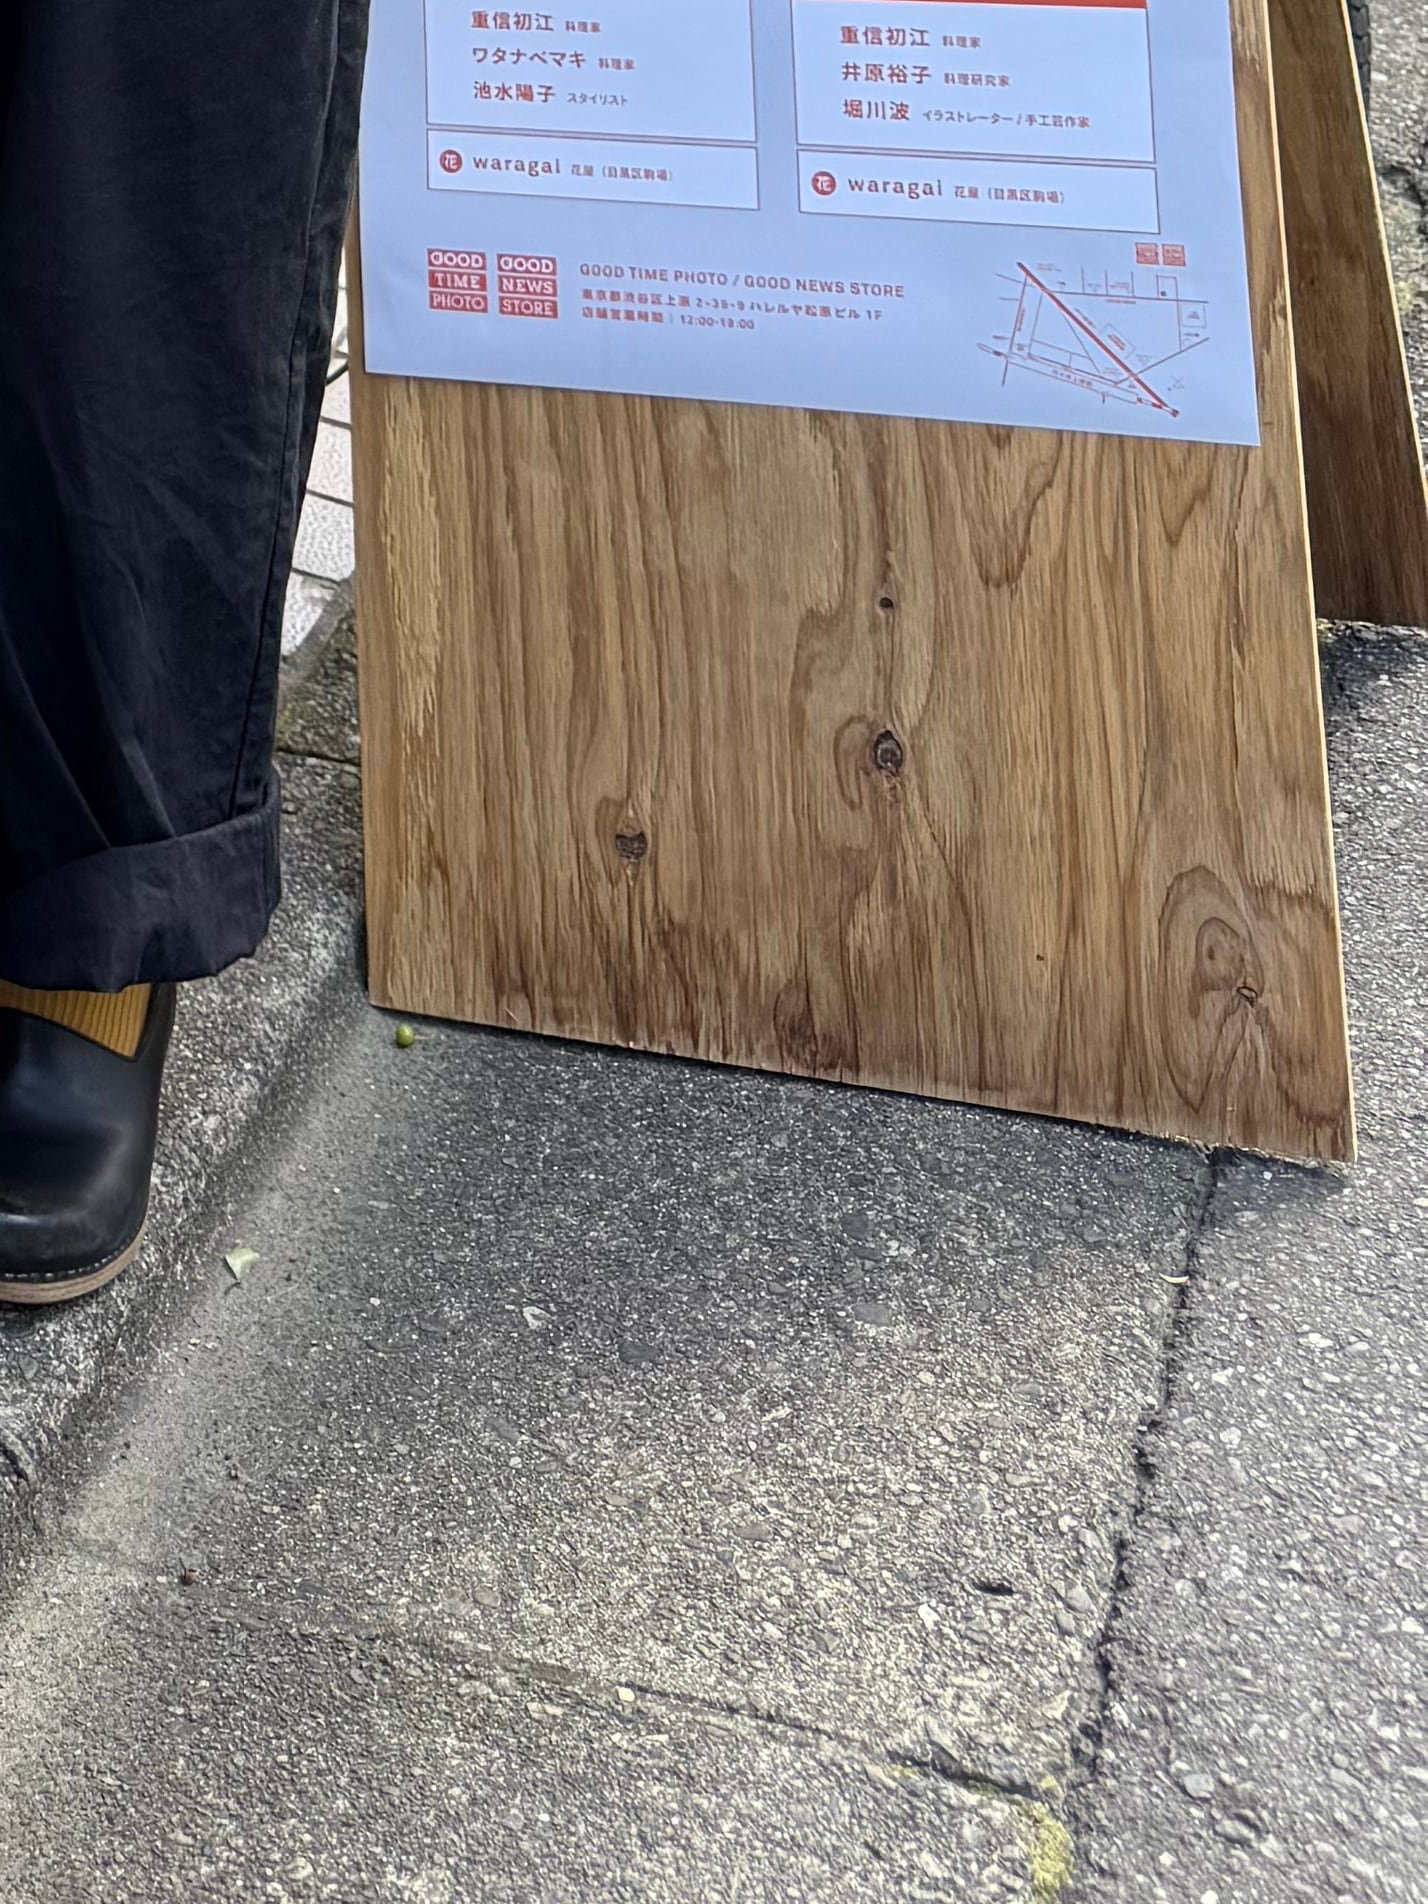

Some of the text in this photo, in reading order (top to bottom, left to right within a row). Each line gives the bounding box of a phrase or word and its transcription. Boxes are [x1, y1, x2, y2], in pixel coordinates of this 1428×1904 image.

[471, 10, 554, 32] 重信初江
[839, 26, 930, 47] 重信初江
[472, 47, 586, 69] ワタナベマキ
[841, 62, 931, 85] 井原裕子
[842, 98, 910, 121] 堀川波
[430, 251, 484, 268] GOOD
[500, 256, 554, 273] GOOD
[434, 272, 481, 289] TIME
[501, 278, 554, 295] NEWS
[628, 266, 668, 281] TIME
[673, 270, 728, 286] PHOTO
[796, 279, 845, 294] NEWS
[849, 281, 905, 297] STORE
[432, 293, 485, 310] PHOTO
[502, 299, 554, 316] STORE
